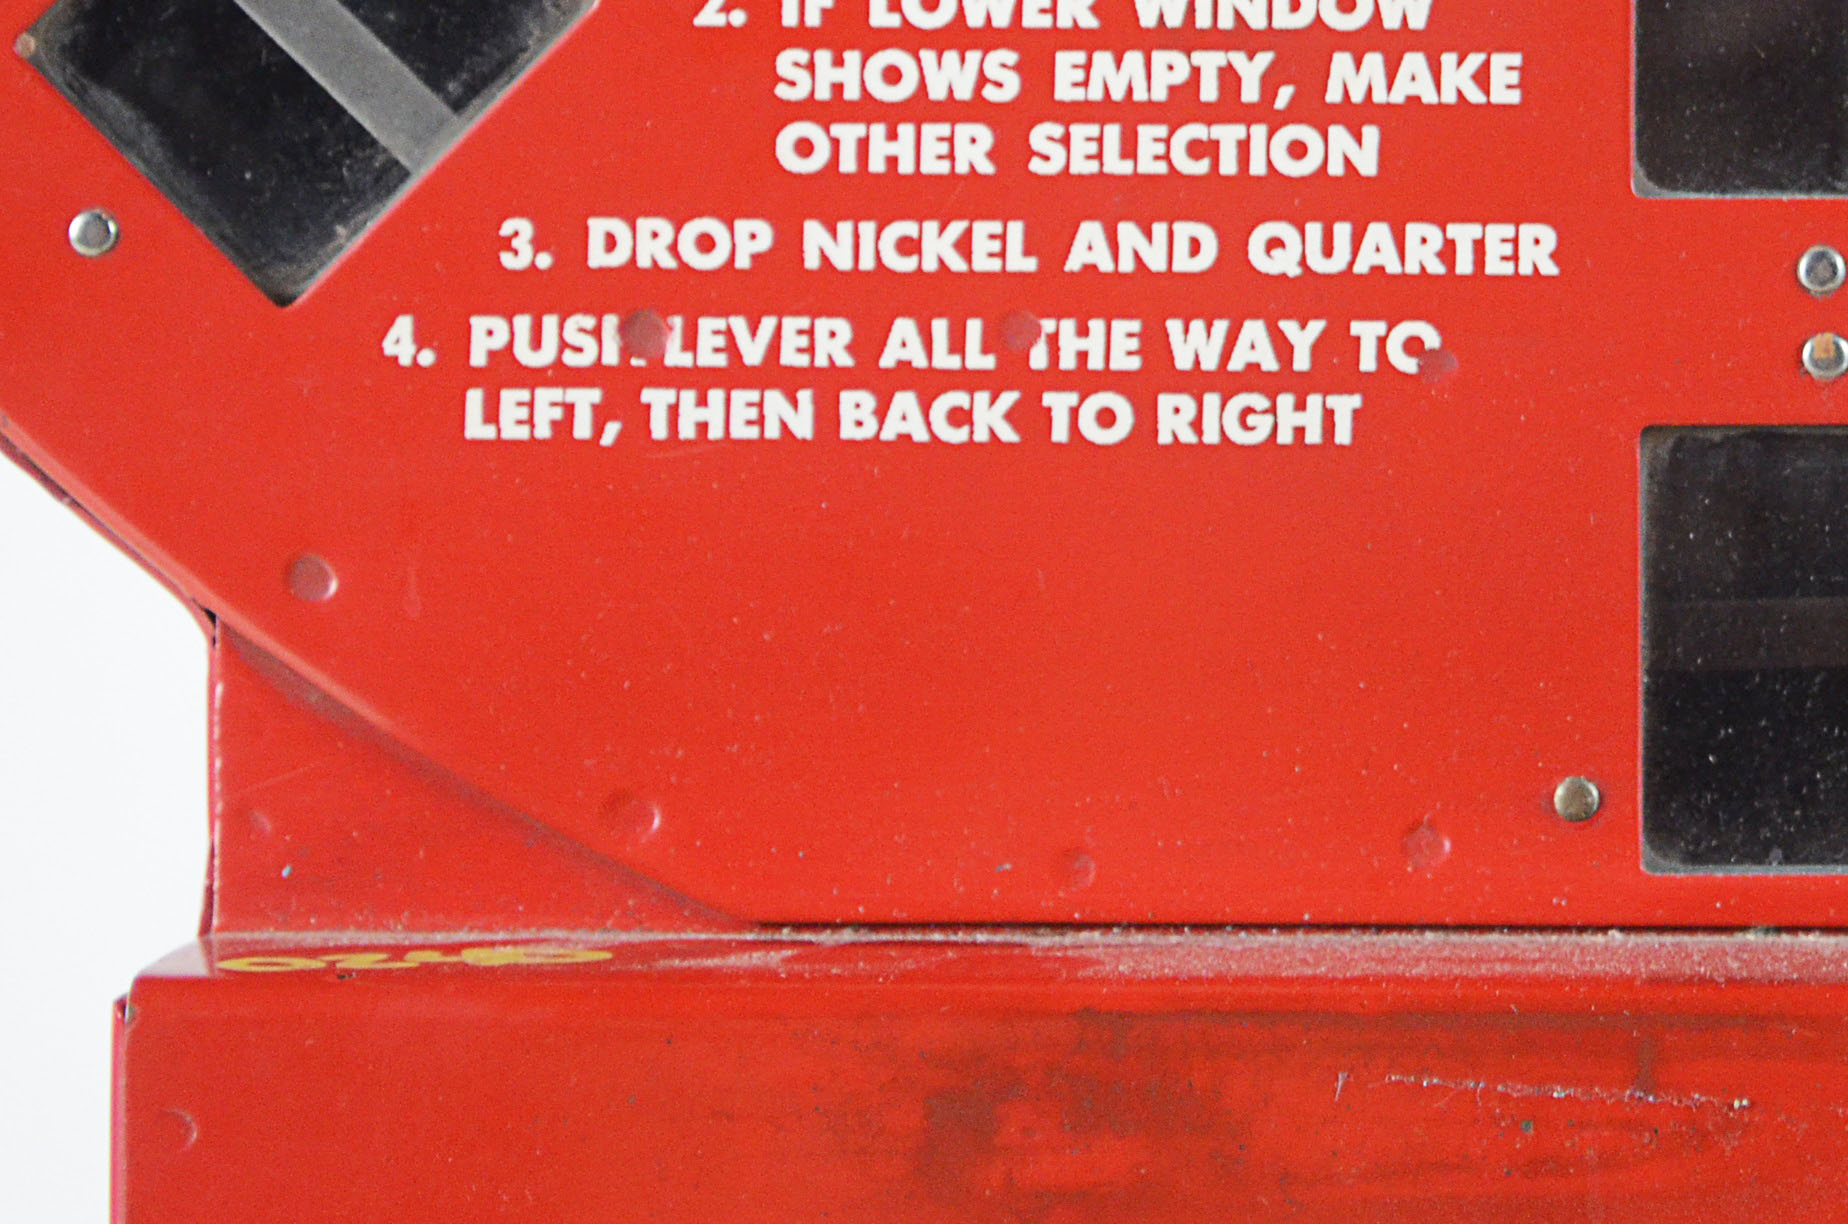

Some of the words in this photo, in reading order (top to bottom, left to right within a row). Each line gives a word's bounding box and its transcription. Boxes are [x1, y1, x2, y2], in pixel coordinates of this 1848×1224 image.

[773, 47, 1022, 103] SHOWS
[1053, 49, 1296, 111] EMPTY,
[1324, 51, 1523, 105] MAKE
[775, 120, 997, 176] OTHER
[1027, 121, 1381, 178] SELECTION
[498, 217, 554, 271] 3.
[586, 216, 774, 271] DROP
[802, 219, 1039, 273] NICKEL
[1063, 220, 1219, 274] AND
[1247, 220, 1561, 279] QUARTER
[381, 314, 437, 368] 4.
[663, 315, 856, 369] LEVER
[878, 316, 997, 371] ALL
[1028, 317, 1143, 372] THE
[1165, 318, 1328, 372] WAY
[1349, 320, 1442, 375] TO
[464, 386, 623, 447] LEFT,
[639, 387, 815, 441] THEN
[838, 389, 1022, 445] BACK
[1041, 390, 1135, 446] TO
[1157, 391, 1363, 446] RIGHT
